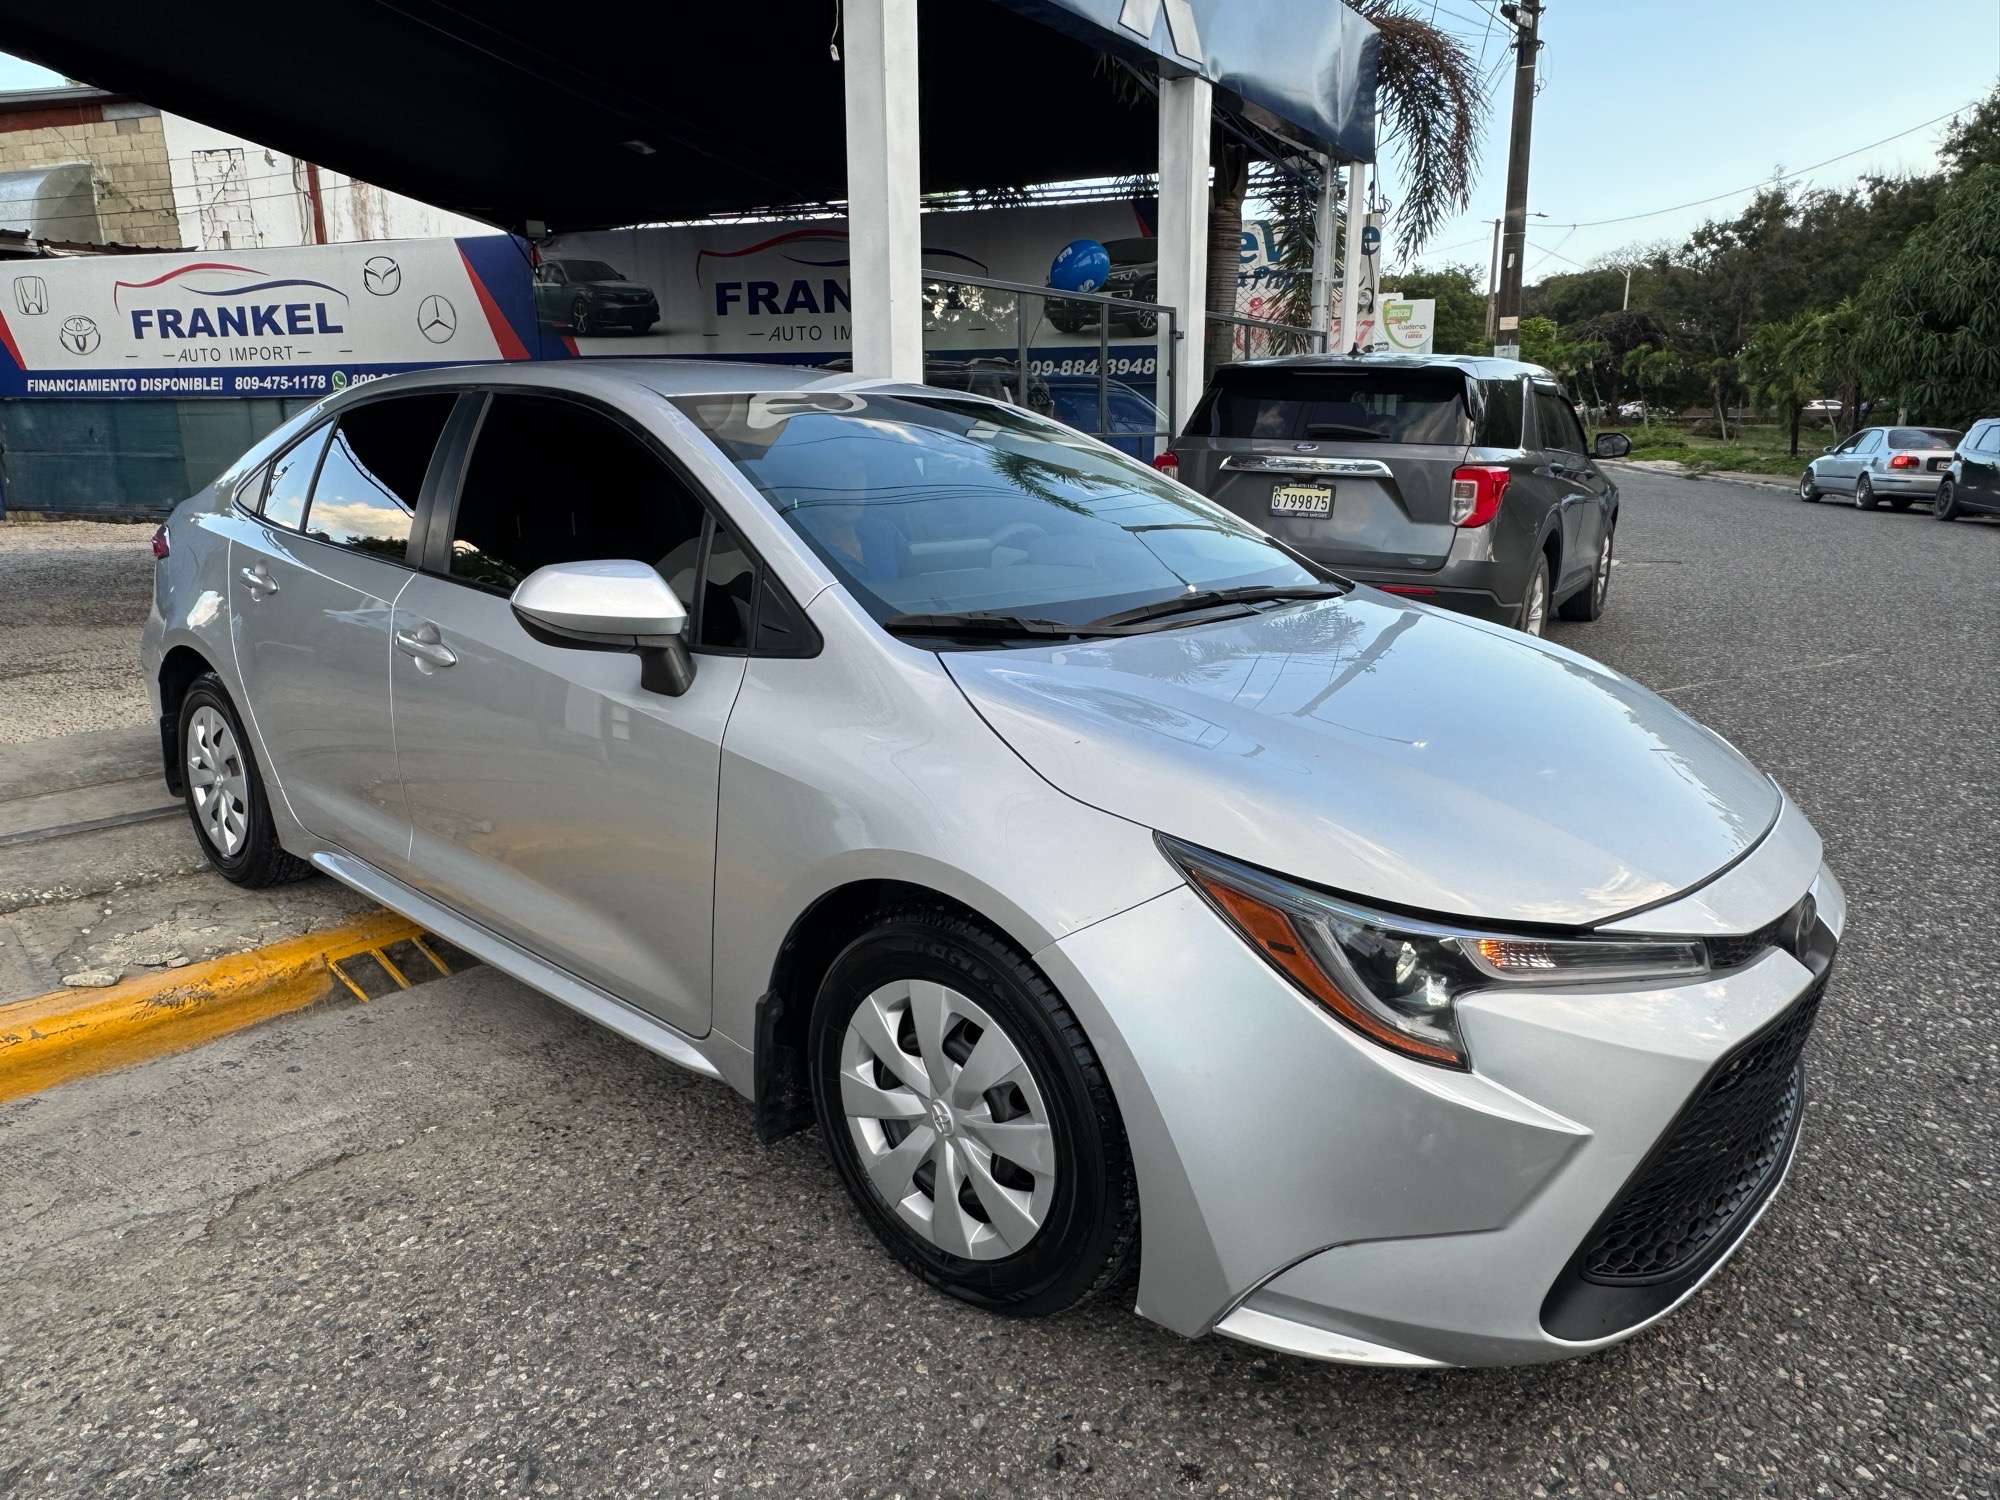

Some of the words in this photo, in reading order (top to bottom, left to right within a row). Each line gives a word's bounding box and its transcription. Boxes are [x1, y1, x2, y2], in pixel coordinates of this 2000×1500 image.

[715, 279, 852, 316] FRAN
[131, 302, 343, 340] FRANKEL
[768, 325, 823, 342] AUTO
[177, 347, 221, 363] AUTO
[229, 345, 293, 361] IMPORT
[1030, 357, 1156, 376] 09-8843948
[27, 377, 137, 393] FINANCIAMIENTO
[140, 376, 224, 392] DISPONIBLE!
[234, 374, 326, 390] 809-475-1178
[1273, 493, 1329, 511] G799875
